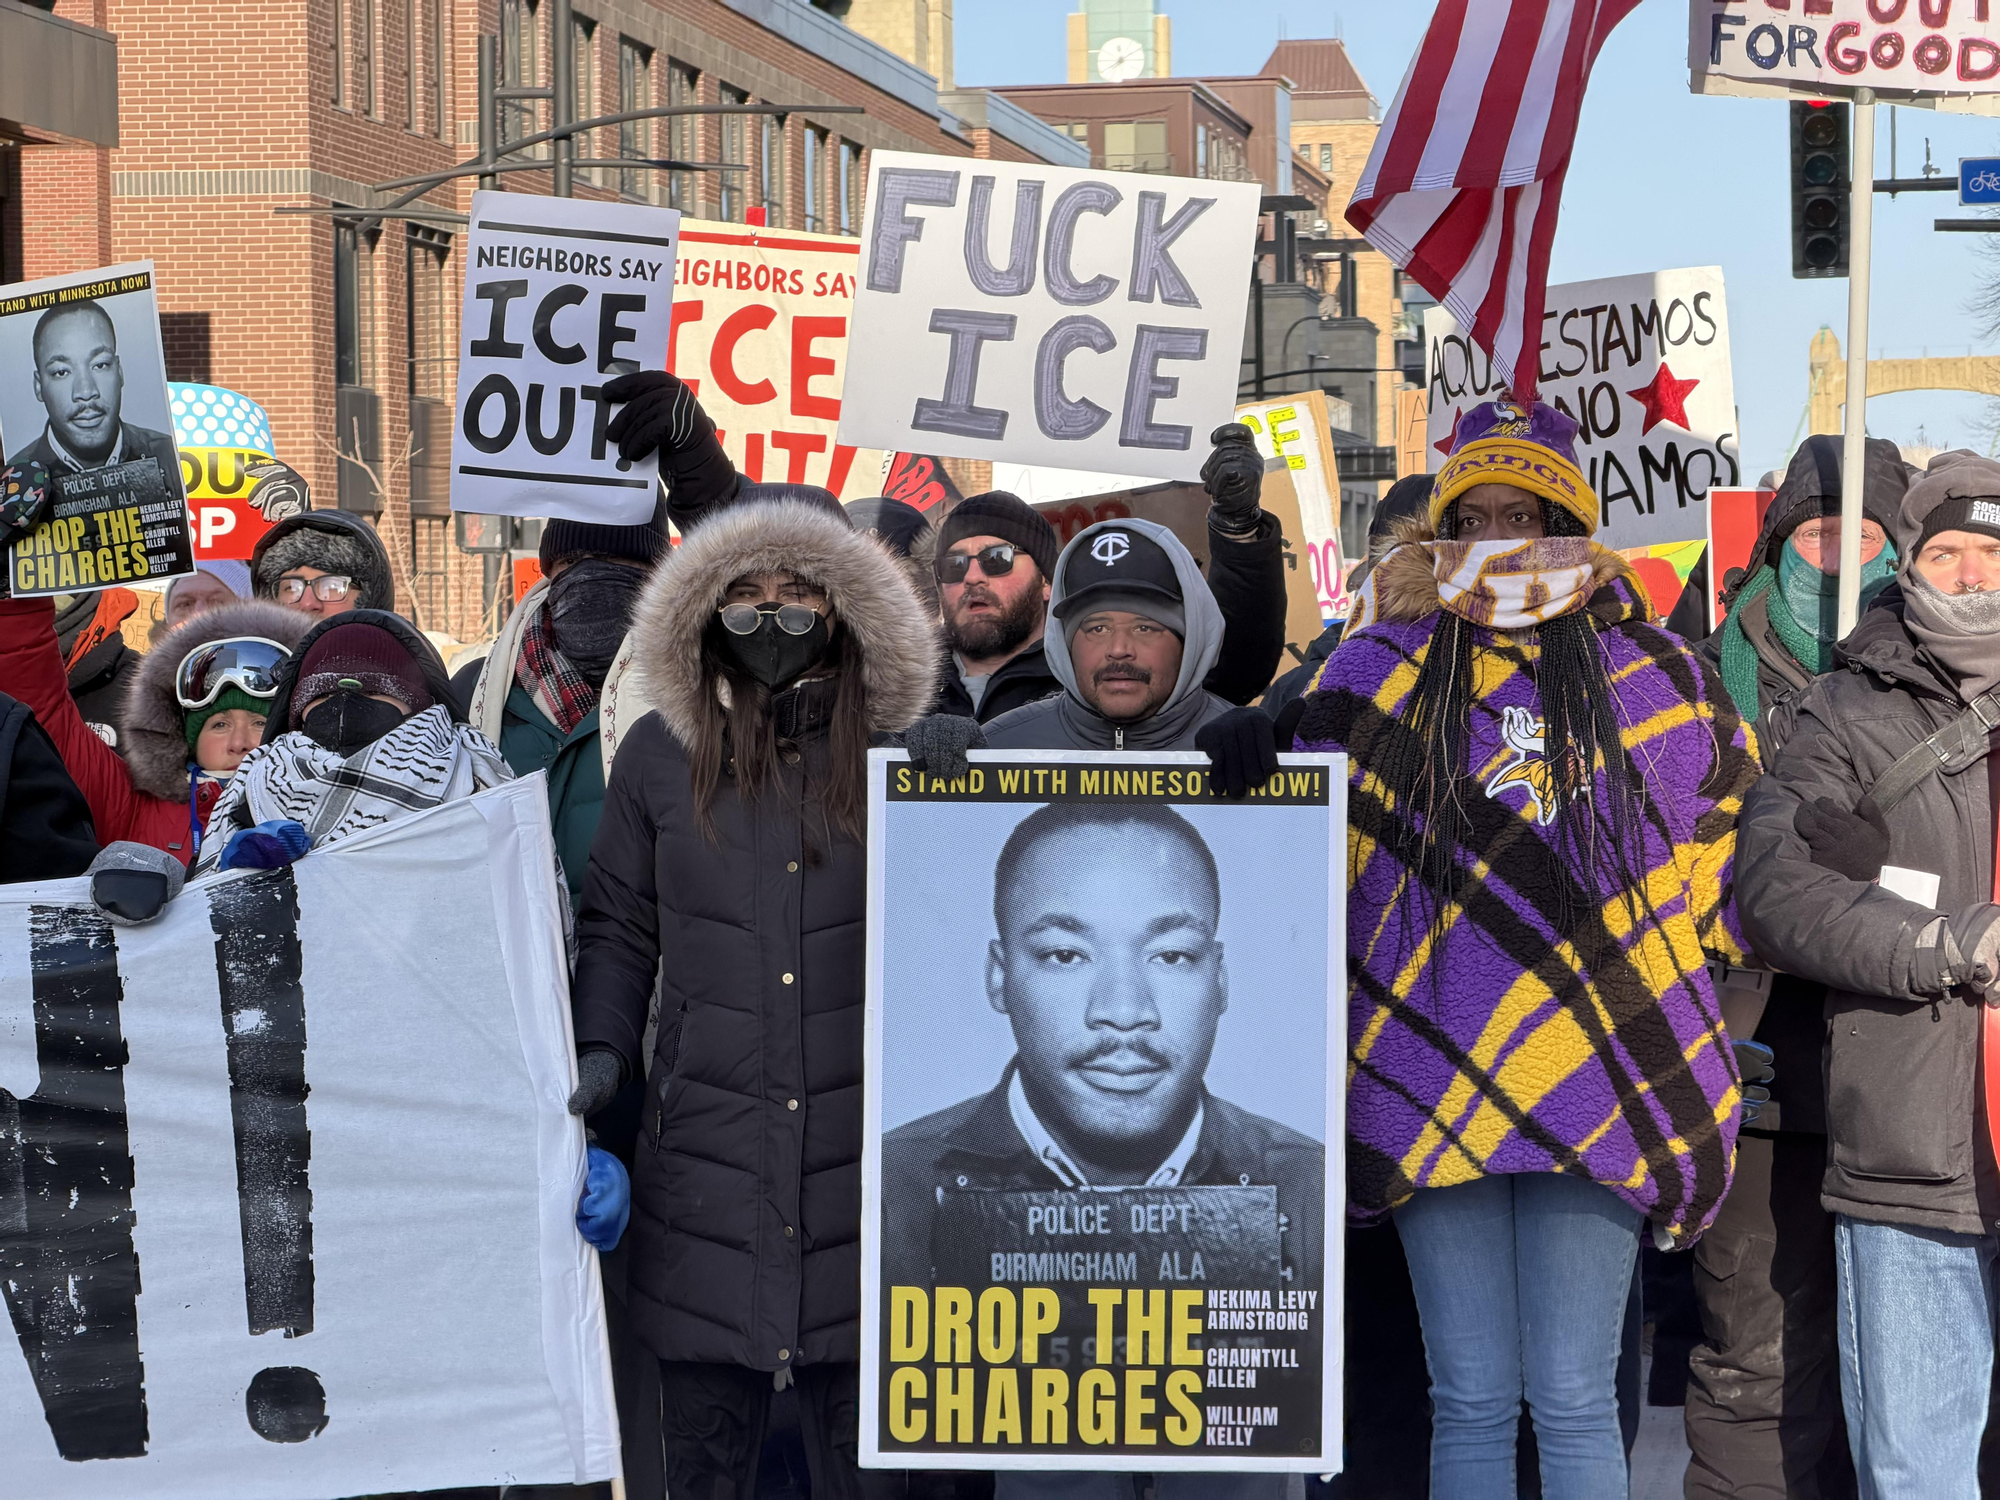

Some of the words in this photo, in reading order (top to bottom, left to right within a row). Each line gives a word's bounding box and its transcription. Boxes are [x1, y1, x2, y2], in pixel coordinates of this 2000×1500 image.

[1710, 14, 1822, 70] FOR
[1825, 21, 2000, 82] GOOD
[866, 167, 1217, 309] FUCK
[477, 246, 613, 278] NEIGHBORS
[619, 258, 663, 282] SAY
[0, 298, 26, 314] TAND
[29, 292, 56, 308] WITH
[59, 281, 118, 303] MINNESOTA
[121, 275, 149, 291] NOW!
[470, 279, 646, 375] ICE
[1538, 291, 1717, 383] ESTAMOS
[910, 308, 1209, 450] ICE
[463, 374, 634, 473] OUT
[63, 477, 98, 496] POLICE
[102, 470, 128, 488] DEPT
[53, 494, 112, 518] BIRMINGHAM
[118, 490, 138, 506] ALA
[140, 502, 166, 515] NEKIMA
[167, 499, 183, 511] LEVY
[141, 509, 182, 524] ARMSTRONG
[93, 507, 144, 547] THE
[144, 525, 181, 540] CHAUNTYLL
[145, 537, 166, 549] ALLEN
[17, 541, 149, 590] CHARGES
[148, 552, 177, 566] WILLIAM
[150, 562, 169, 574] KELLY
[896, 767, 985, 794] STAND
[998, 769, 1067, 795] WITH
[1080, 770, 1228, 797] MINNESO
[1027, 1205, 1110, 1236] POLICE
[1131, 1204, 1192, 1235] DEPT
[990, 1251, 1137, 1282] BIRMINGHAM
[1159, 1251, 1206, 1281] ALA
[1208, 1289, 1271, 1310] NEKIMA
[1279, 1290, 1318, 1310] LEVY
[890, 1285, 1060, 1364] DROP
[1088, 1288, 1204, 1366] THE
[1207, 1310, 1309, 1331] ARMSTRONG
[1206, 1347, 1299, 1368] CHAUNTYLL
[1206, 1368, 1257, 1389] ALLEN
[888, 1367, 1204, 1447] CHARGES
[1206, 1406, 1279, 1427] WILLIAM
[1206, 1426, 1254, 1447] KELLY
